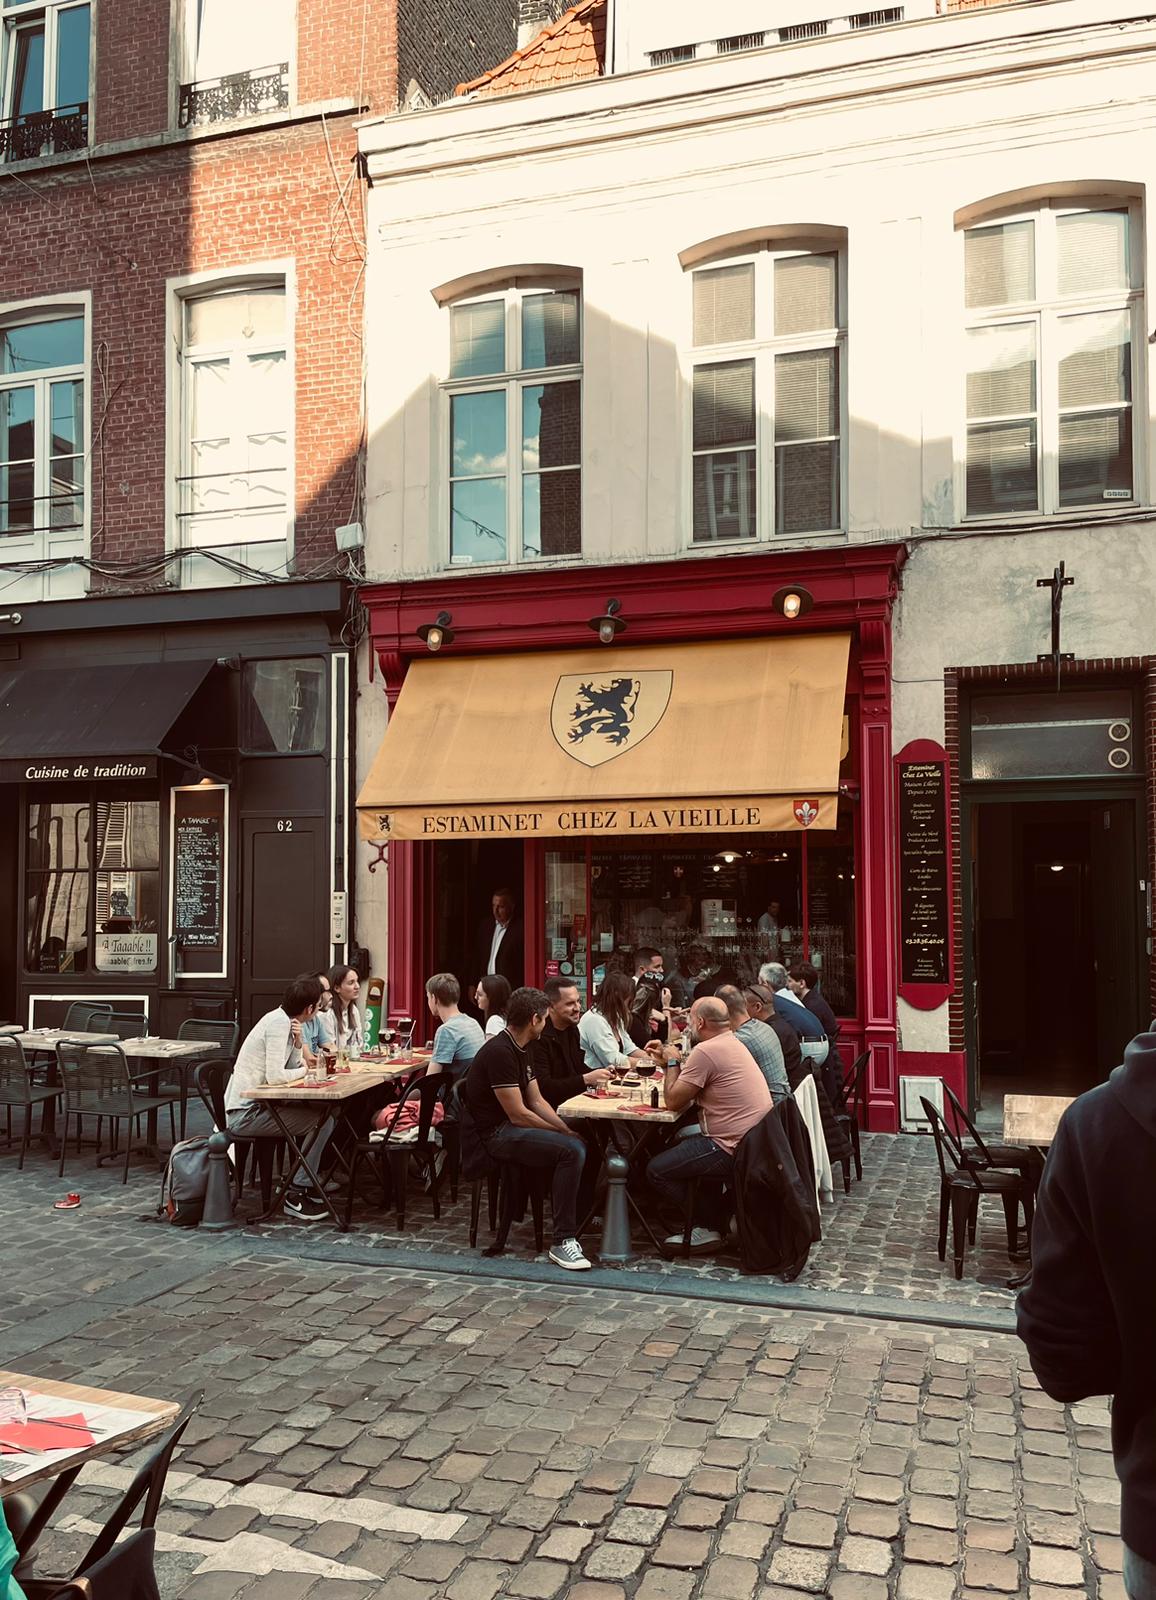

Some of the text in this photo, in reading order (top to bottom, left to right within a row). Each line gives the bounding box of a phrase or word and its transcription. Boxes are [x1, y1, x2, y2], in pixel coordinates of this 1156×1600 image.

[25, 764, 146, 779] Cuisine de tradition
[277, 820, 292, 832] 62
[422, 807, 761, 833] ESTAMINET CHEZ LA VIEILLE
[111, 935, 144, 953] Taaable
